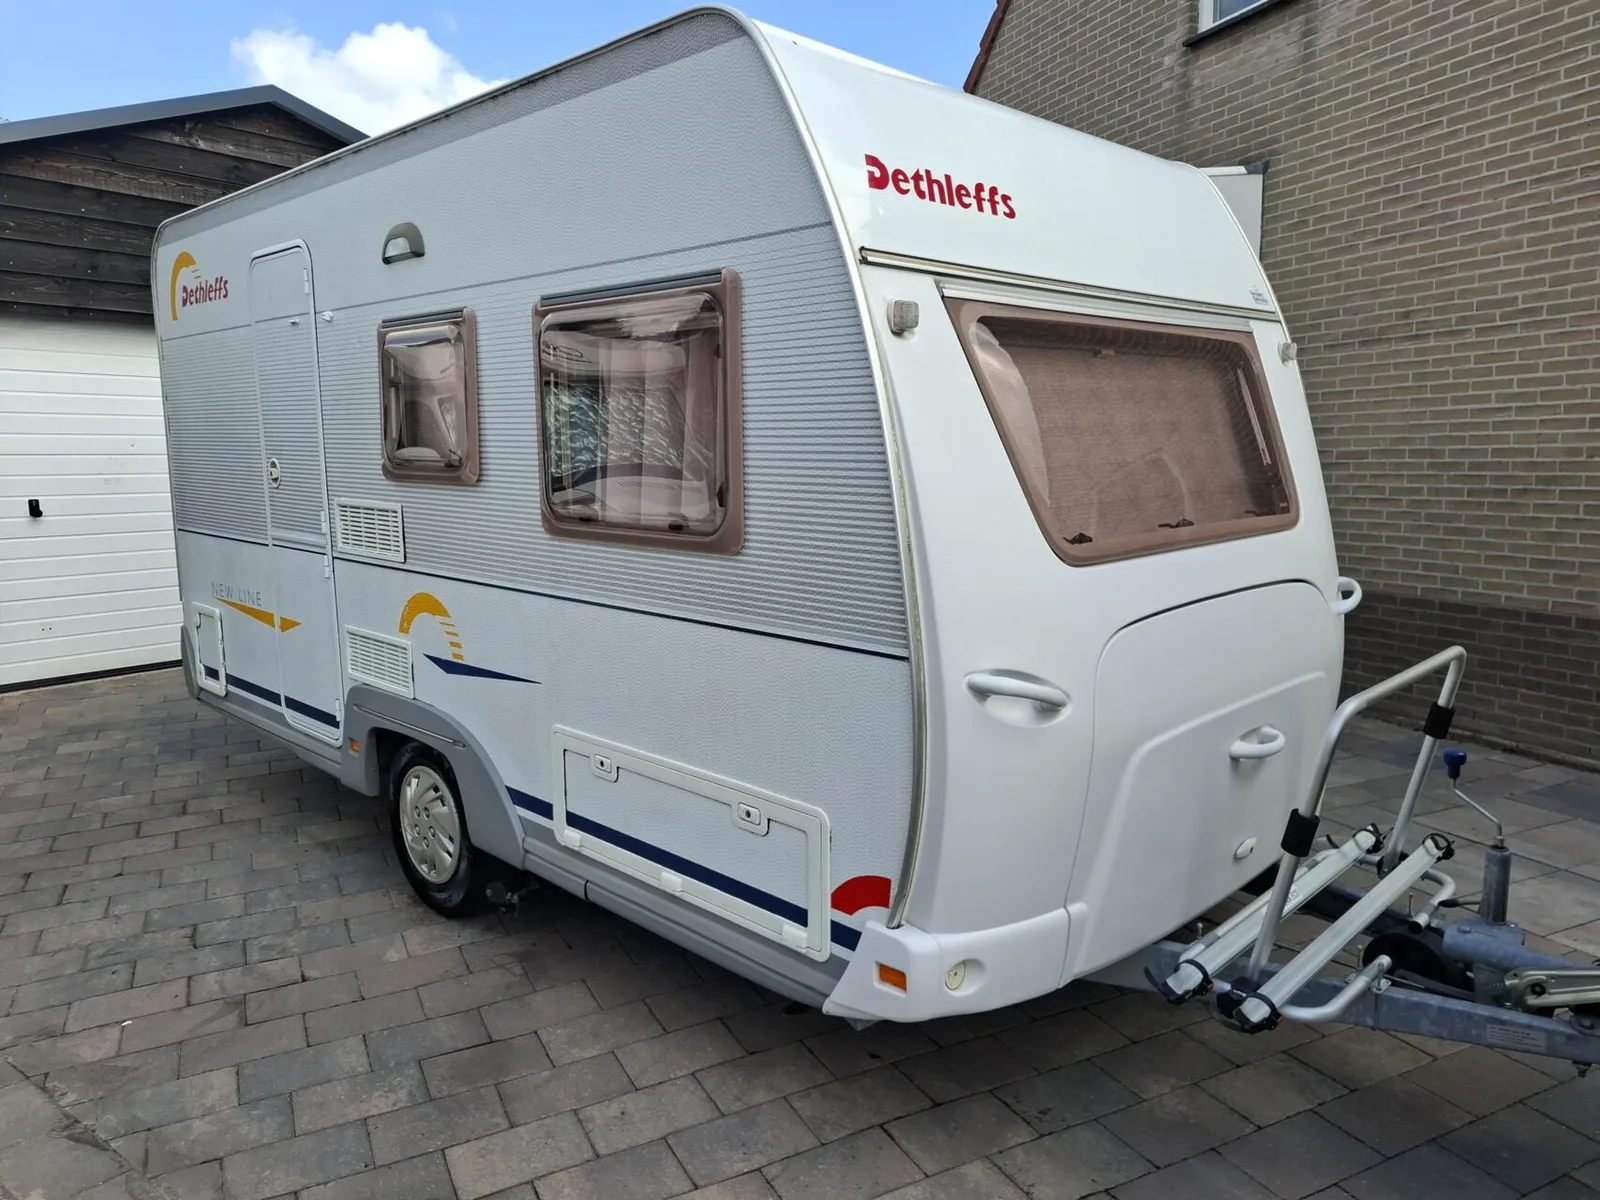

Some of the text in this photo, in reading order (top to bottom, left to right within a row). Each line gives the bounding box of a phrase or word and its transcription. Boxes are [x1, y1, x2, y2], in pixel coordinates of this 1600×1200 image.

[864, 153, 1017, 220] Dethleffs
[182, 275, 228, 307] Dethleffs
[211, 582, 262, 606] NEW LINE
